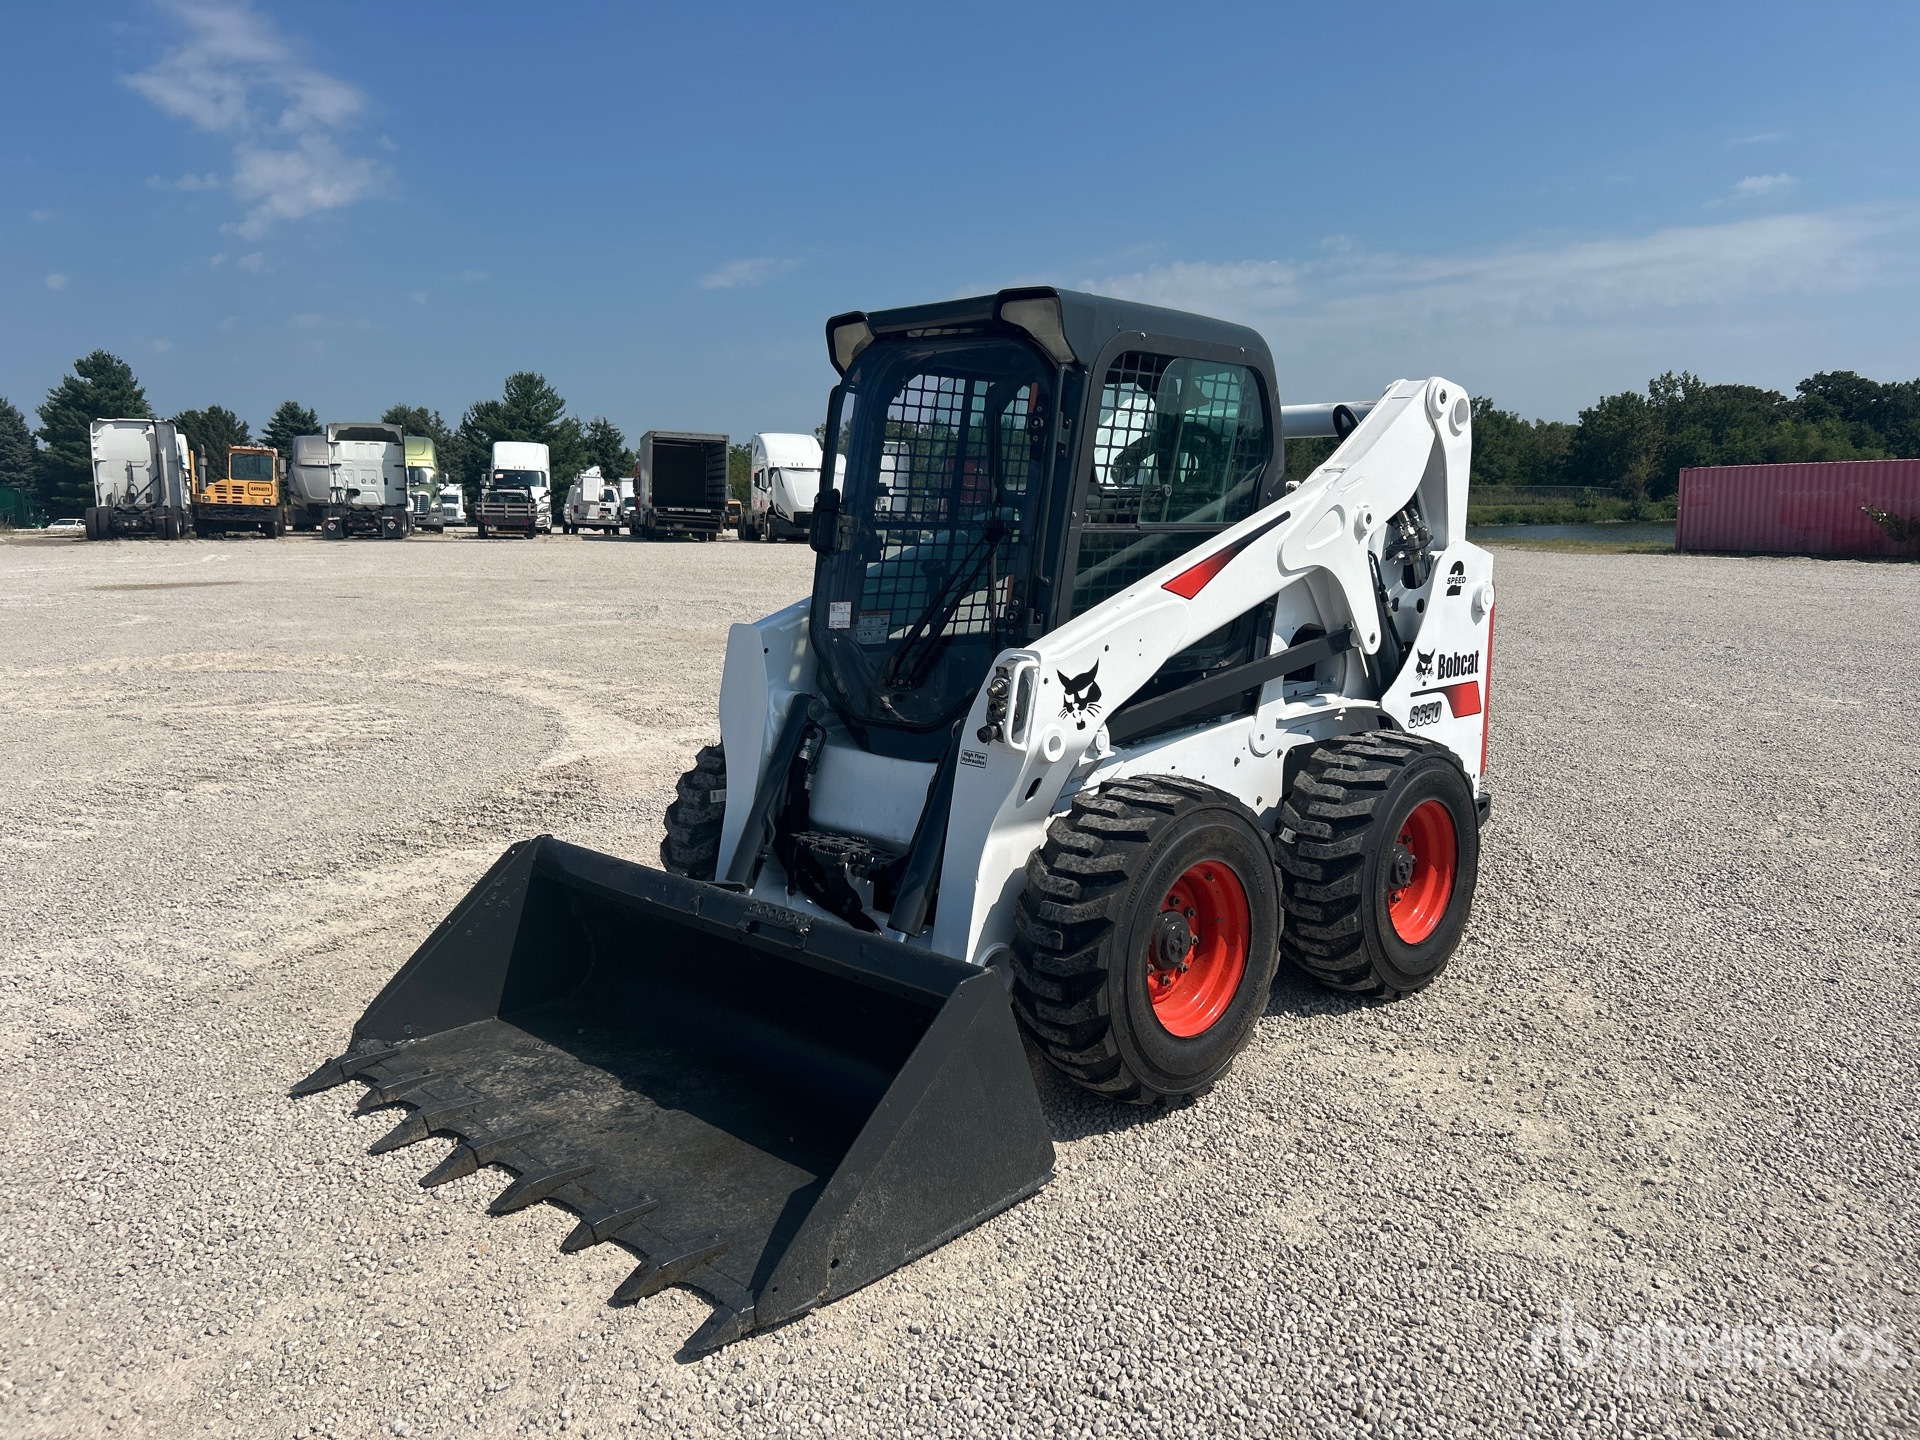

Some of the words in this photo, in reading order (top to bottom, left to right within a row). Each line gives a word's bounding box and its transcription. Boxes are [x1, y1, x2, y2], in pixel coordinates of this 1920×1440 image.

[1446, 561, 1465, 596] 2
[1447, 576, 1466, 585] SPEED
[1437, 650, 1480, 680] Bobcat
[1408, 701, 1442, 728] S650
